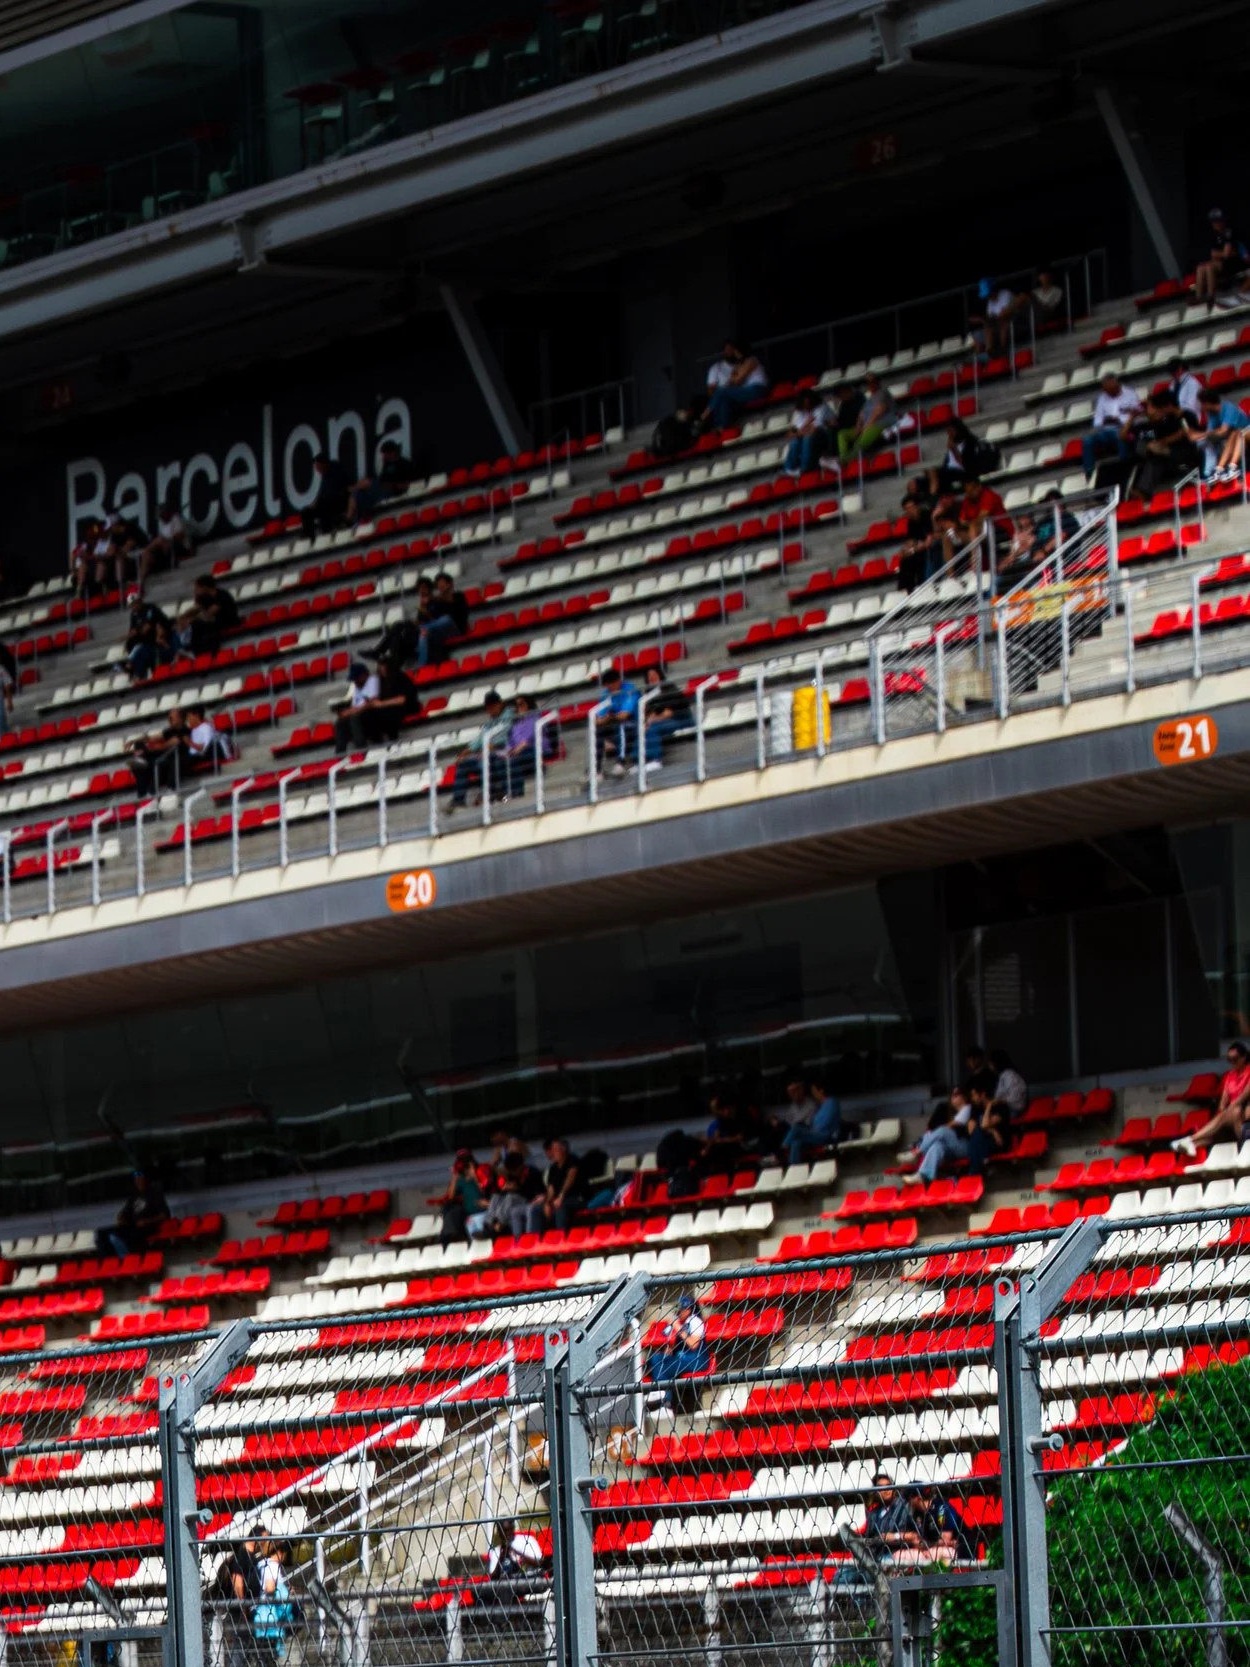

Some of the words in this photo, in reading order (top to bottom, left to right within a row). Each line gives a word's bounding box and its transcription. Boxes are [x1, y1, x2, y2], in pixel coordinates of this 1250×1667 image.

[66, 397, 413, 563] Barcelona
[1176, 718, 1211, 759] 21
[403, 872, 433, 908] 20
